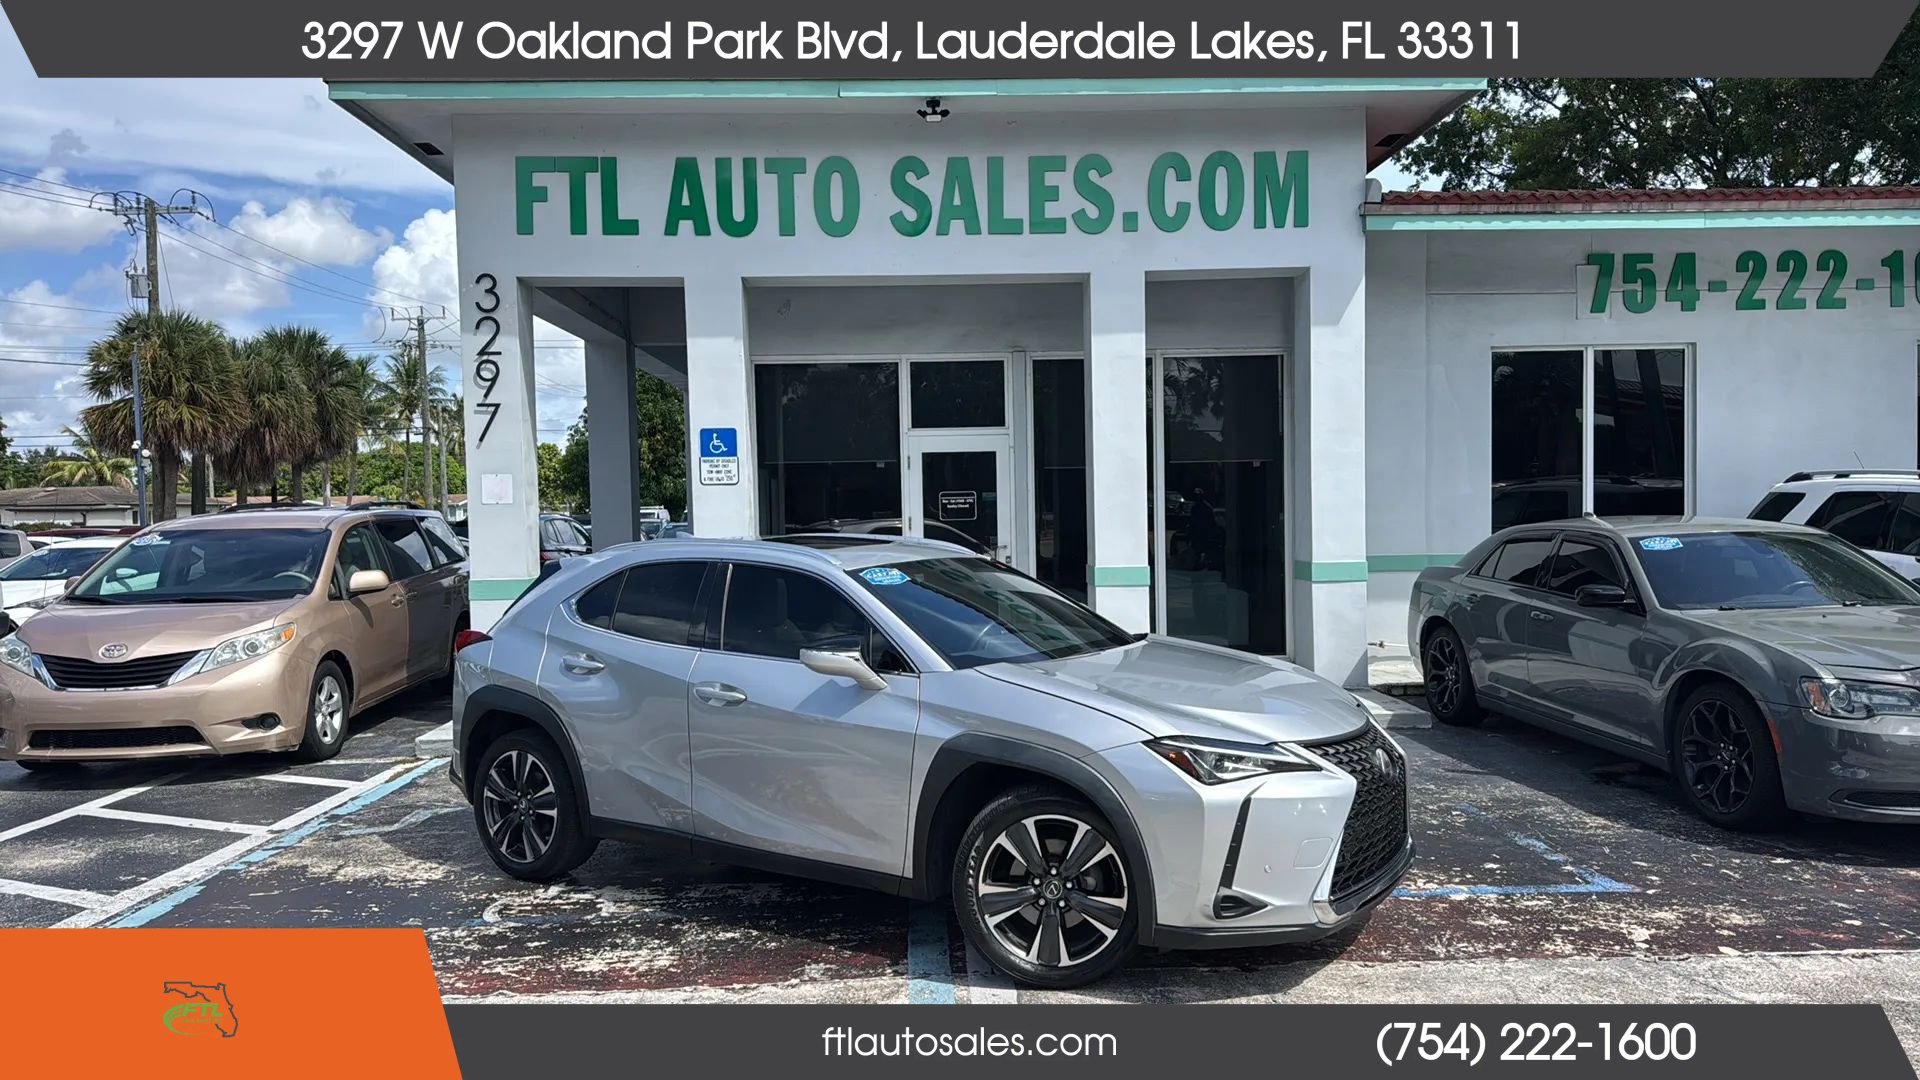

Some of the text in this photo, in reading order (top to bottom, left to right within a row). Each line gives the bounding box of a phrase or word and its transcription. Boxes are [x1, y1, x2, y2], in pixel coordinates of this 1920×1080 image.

[515, 149, 1312, 240] FTL AUTO SALES.COM
[1587, 249, 1920, 315] 754-222-1
[473, 272, 503, 443] 3297
